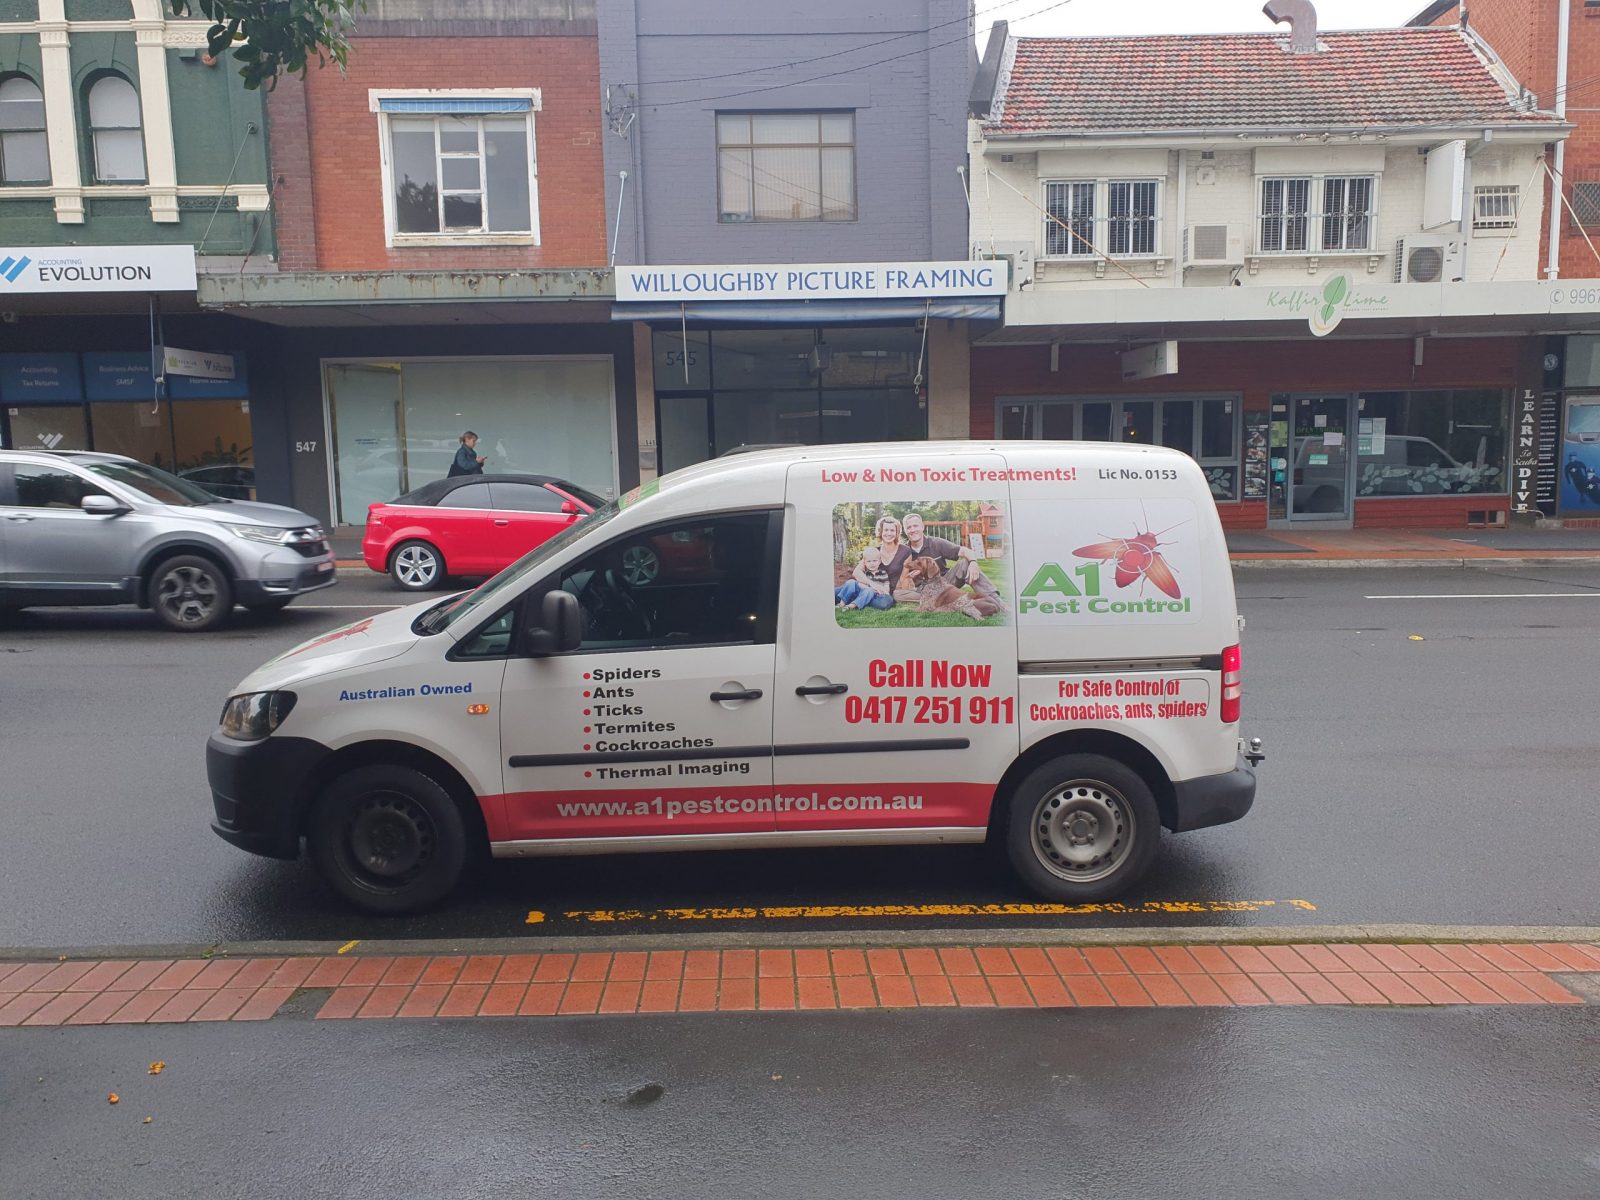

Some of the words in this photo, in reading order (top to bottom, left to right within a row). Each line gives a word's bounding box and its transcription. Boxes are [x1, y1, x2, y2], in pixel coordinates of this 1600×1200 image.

[38, 265, 152, 282] EVOLUTION
[631, 272, 778, 292] WILLOUGHBY
[787, 271, 875, 291] PICTURE
[886, 268, 993, 289] FRAMING
[1267, 290, 1320, 312] Kaffir
[1343, 291, 1388, 307] Lime
[666, 351, 697, 366] 545
[1519, 389, 1535, 447] LEARN
[296, 441, 317, 452] 547
[821, 469, 858, 483] Low
[863, 468, 875, 482] &
[880, 468, 916, 482] Non
[920, 467, 966, 482] Toxic
[969, 467, 1076, 482] Treatments!
[1098, 469, 1117, 480] Lic
[1120, 469, 1142, 480] No.
[1145, 469, 1177, 480] 0153
[1516, 468, 1532, 513] DIVE
[1020, 562, 1100, 597] A1
[1019, 598, 1080, 614] Pest
[1087, 597, 1191, 614] Control
[592, 668, 661, 683] Spiders
[868, 659, 924, 688] Call
[930, 660, 992, 688] Now
[339, 687, 415, 701] Australian
[420, 682, 472, 696] Owned
[593, 686, 635, 699] Ants
[1058, 680, 1080, 697] For
[1082, 679, 1112, 697] Safe
[1115, 679, 1164, 696] Control
[1167, 679, 1180, 695] of
[593, 704, 644, 717] Ticks
[845, 696, 908, 724] 0417
[914, 696, 962, 724] 251
[969, 696, 1014, 724] 911
[1030, 702, 1123, 721] Cockroaches,
[1124, 702, 1156, 719] ants,
[1158, 701, 1208, 718] spiders
[594, 721, 676, 735] Termites
[595, 736, 714, 752] Cockroaches
[596, 764, 672, 780] Thermal
[678, 761, 750, 775] Imaging
[557, 792, 923, 820] www.a1pestcontrol.com.au
